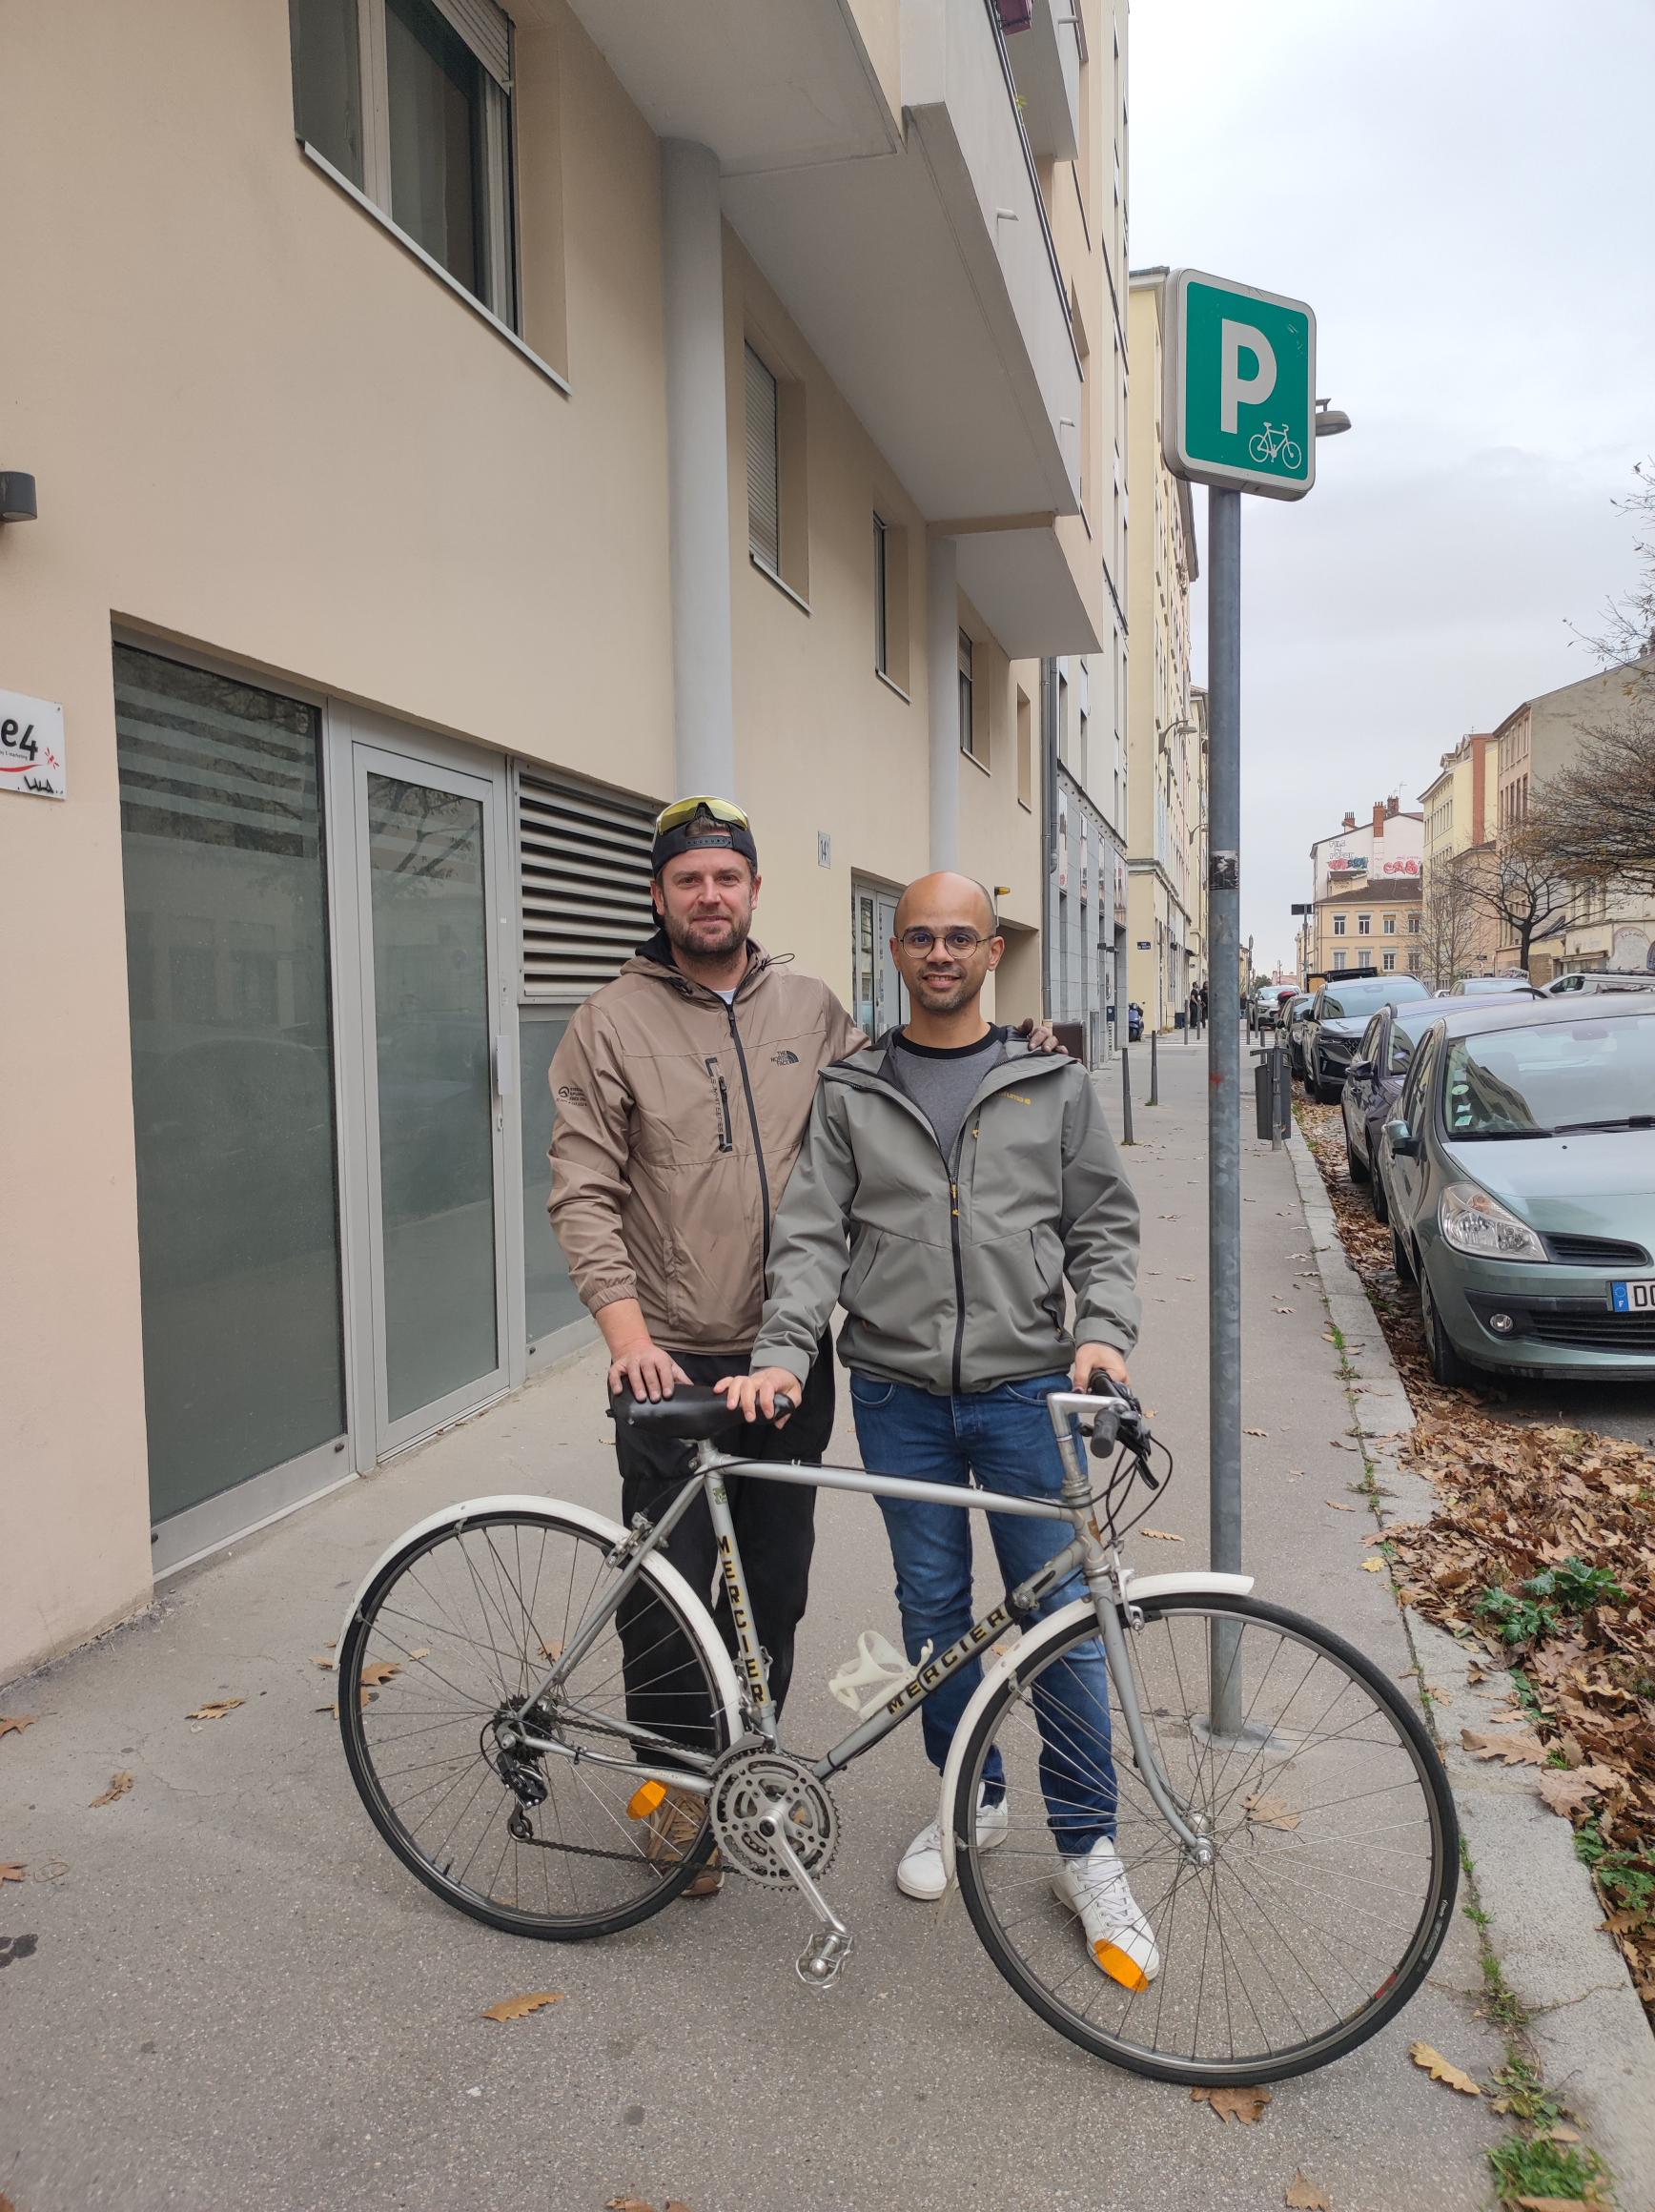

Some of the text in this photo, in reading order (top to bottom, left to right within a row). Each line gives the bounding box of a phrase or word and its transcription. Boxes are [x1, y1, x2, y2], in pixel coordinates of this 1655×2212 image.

[1221, 318, 1277, 435] P
[1618, 1300, 1624, 1308] F
[716, 1534, 766, 1704] MERCIER
[886, 1608, 1008, 1715] MERCIER
